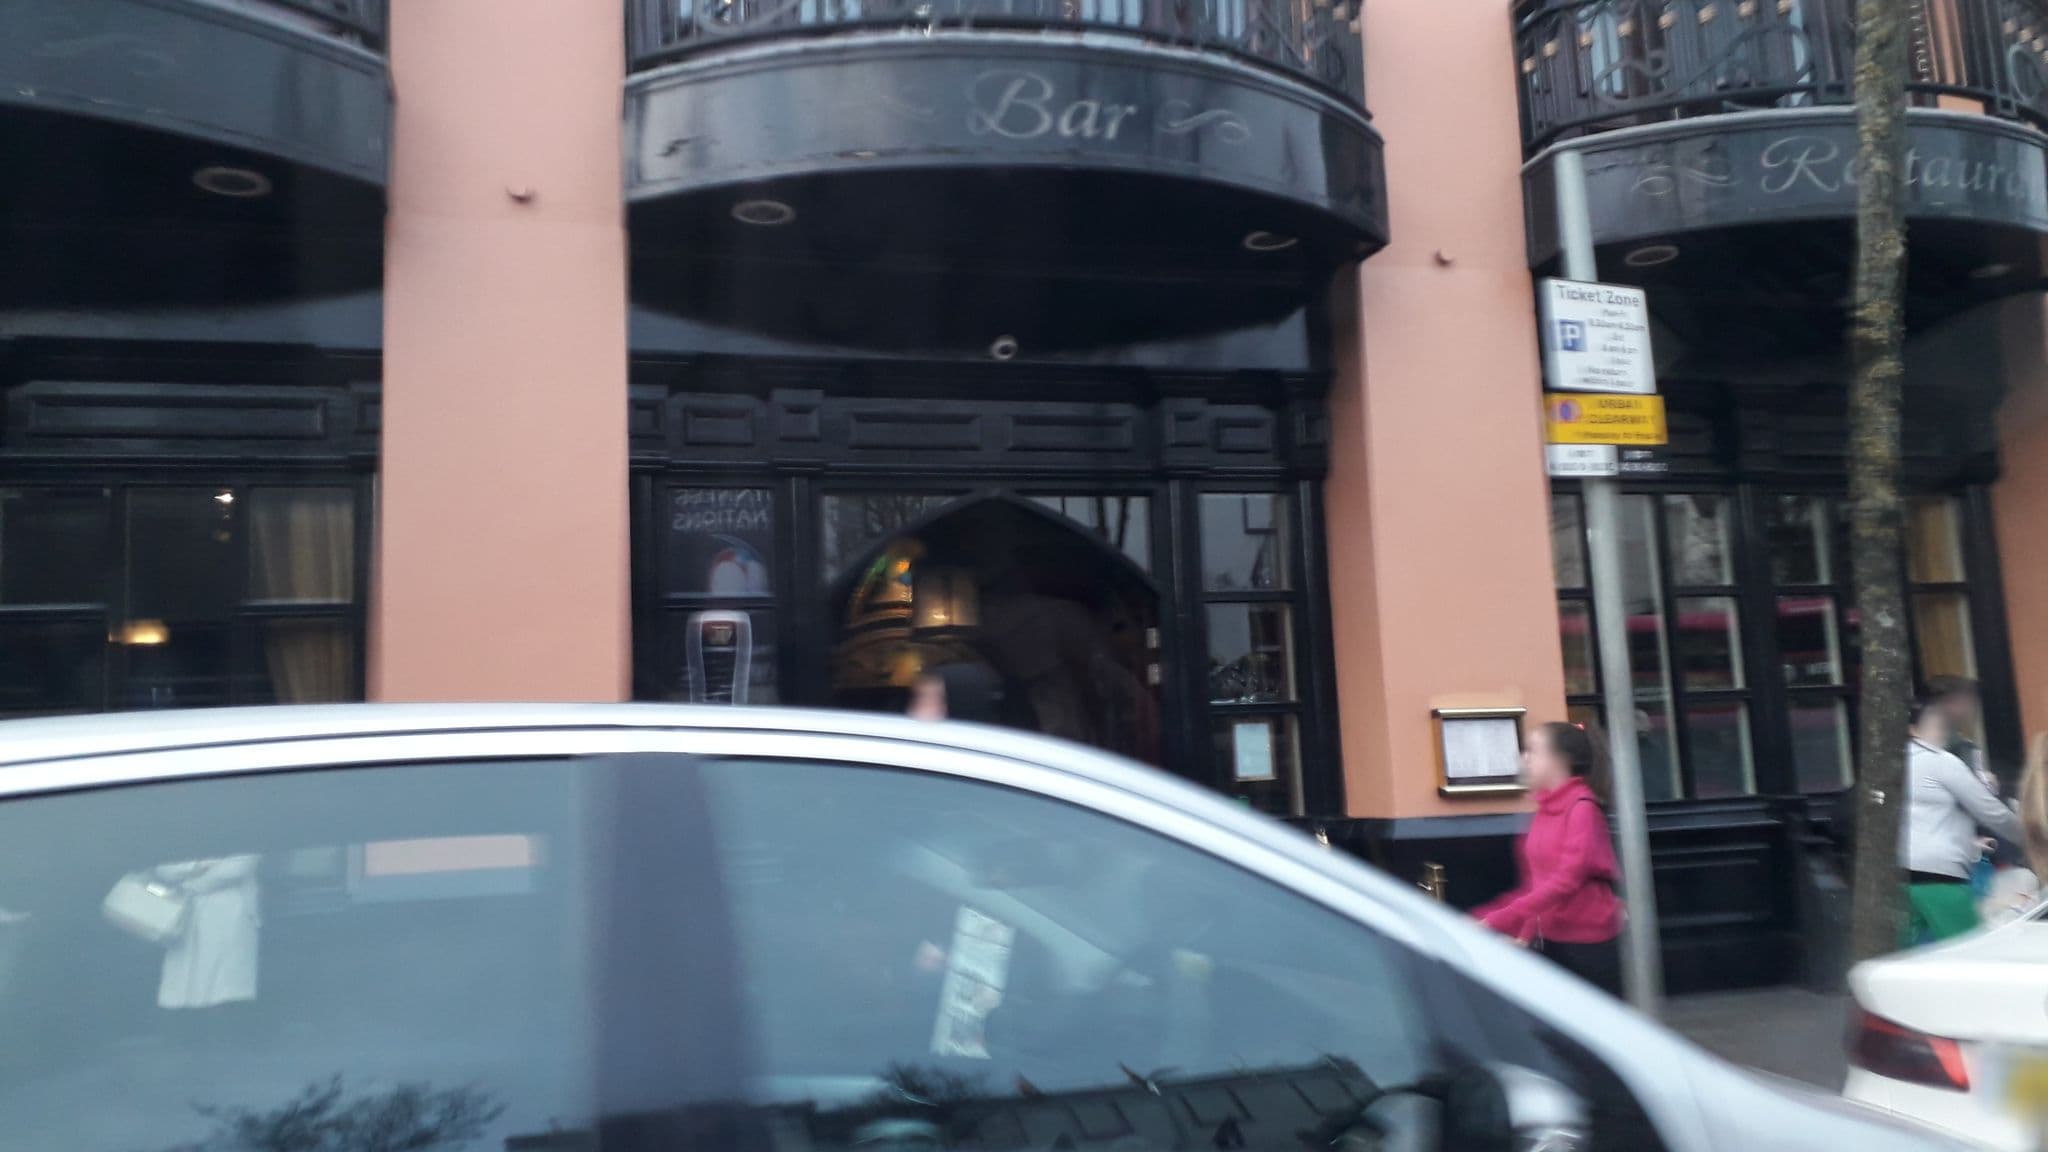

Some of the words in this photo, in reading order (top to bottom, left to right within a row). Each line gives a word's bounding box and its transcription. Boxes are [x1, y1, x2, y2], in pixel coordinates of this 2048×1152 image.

[964, 69, 1138, 140] Bar
[1558, 284, 1602, 304] Ticket
[1606, 289, 1640, 307] Zone
